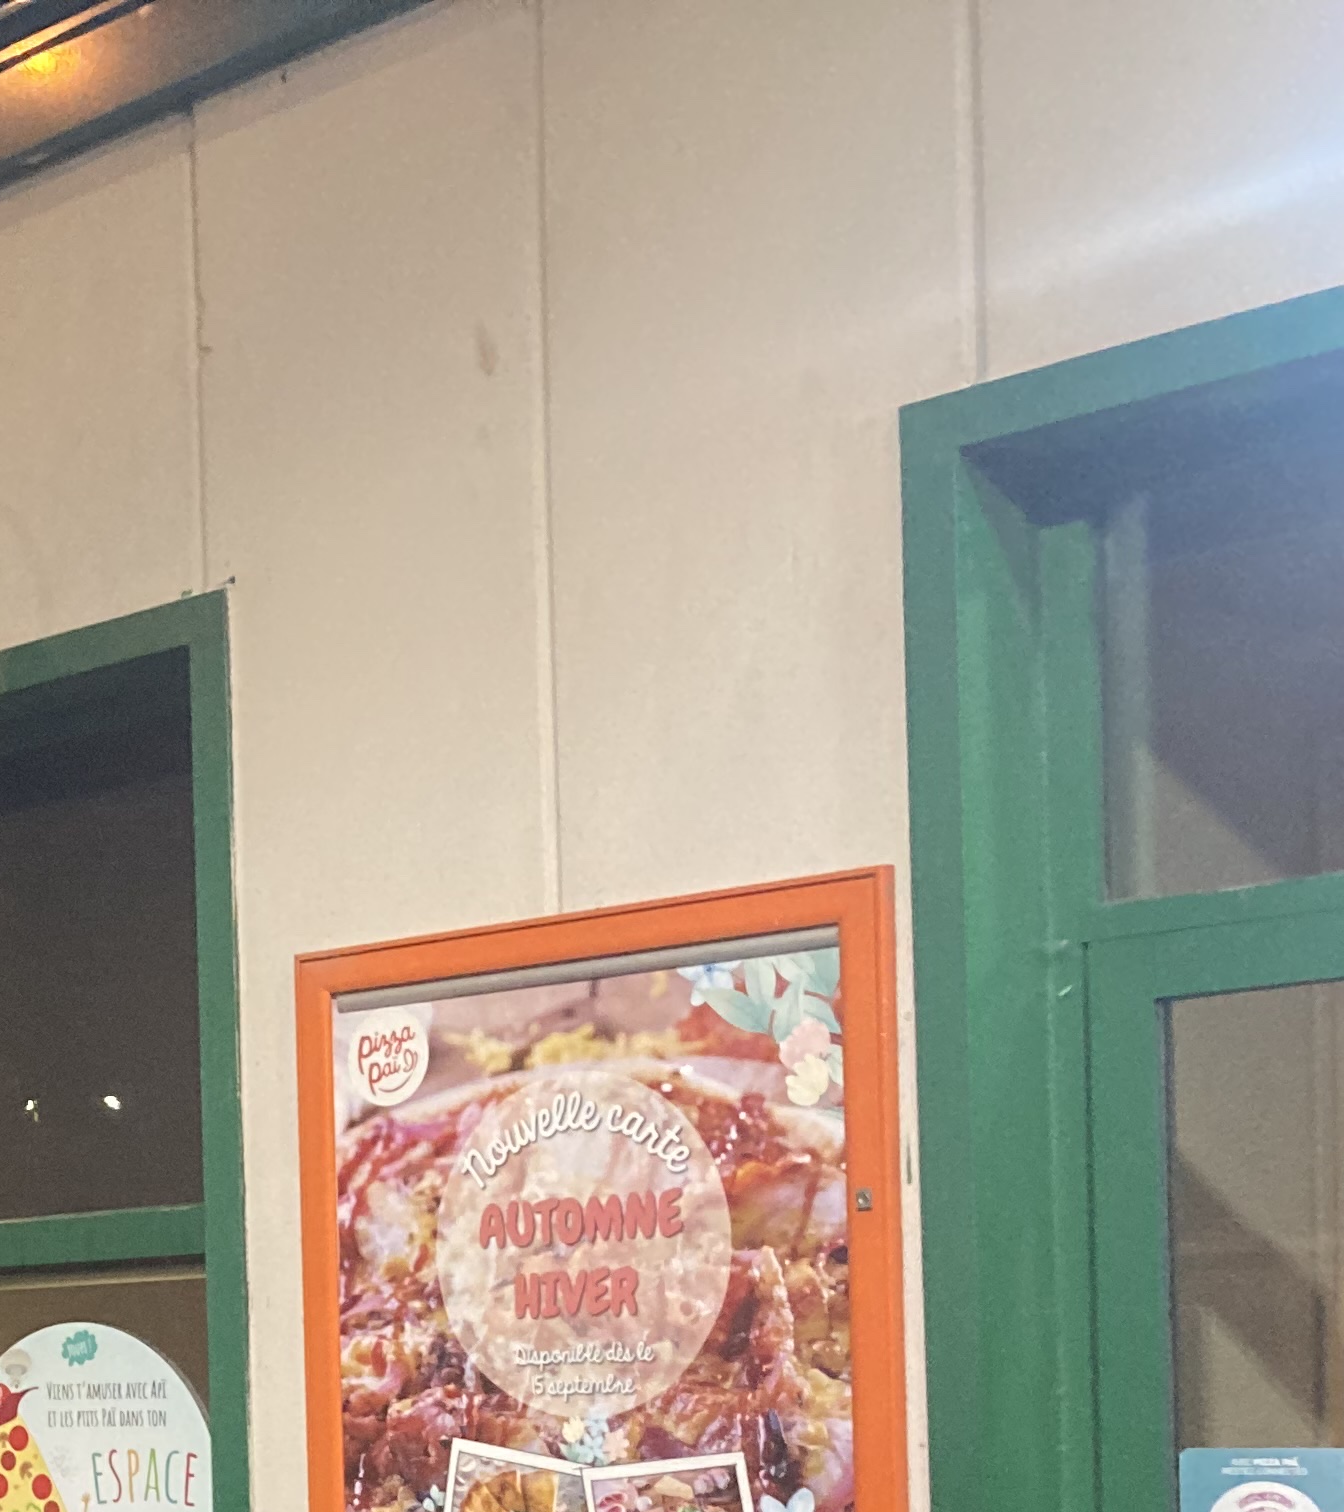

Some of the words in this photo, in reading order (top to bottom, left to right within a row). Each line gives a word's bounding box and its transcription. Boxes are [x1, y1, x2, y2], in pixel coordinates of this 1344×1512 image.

[461, 1091, 601, 1189] Nouvelle
[607, 1104, 690, 1173] carte
[479, 1187, 686, 1249] AUTOMNE
[513, 1266, 639, 1319] HIVER
[513, 1342, 603, 1371] Disponible
[605, 1340, 634, 1363] dès
[636, 1340, 656, 1362] le
[532, 1374, 545, 1395] 15
[547, 1374, 636, 1403] septembre
[92, 1448, 198, 1507] ESPACE
